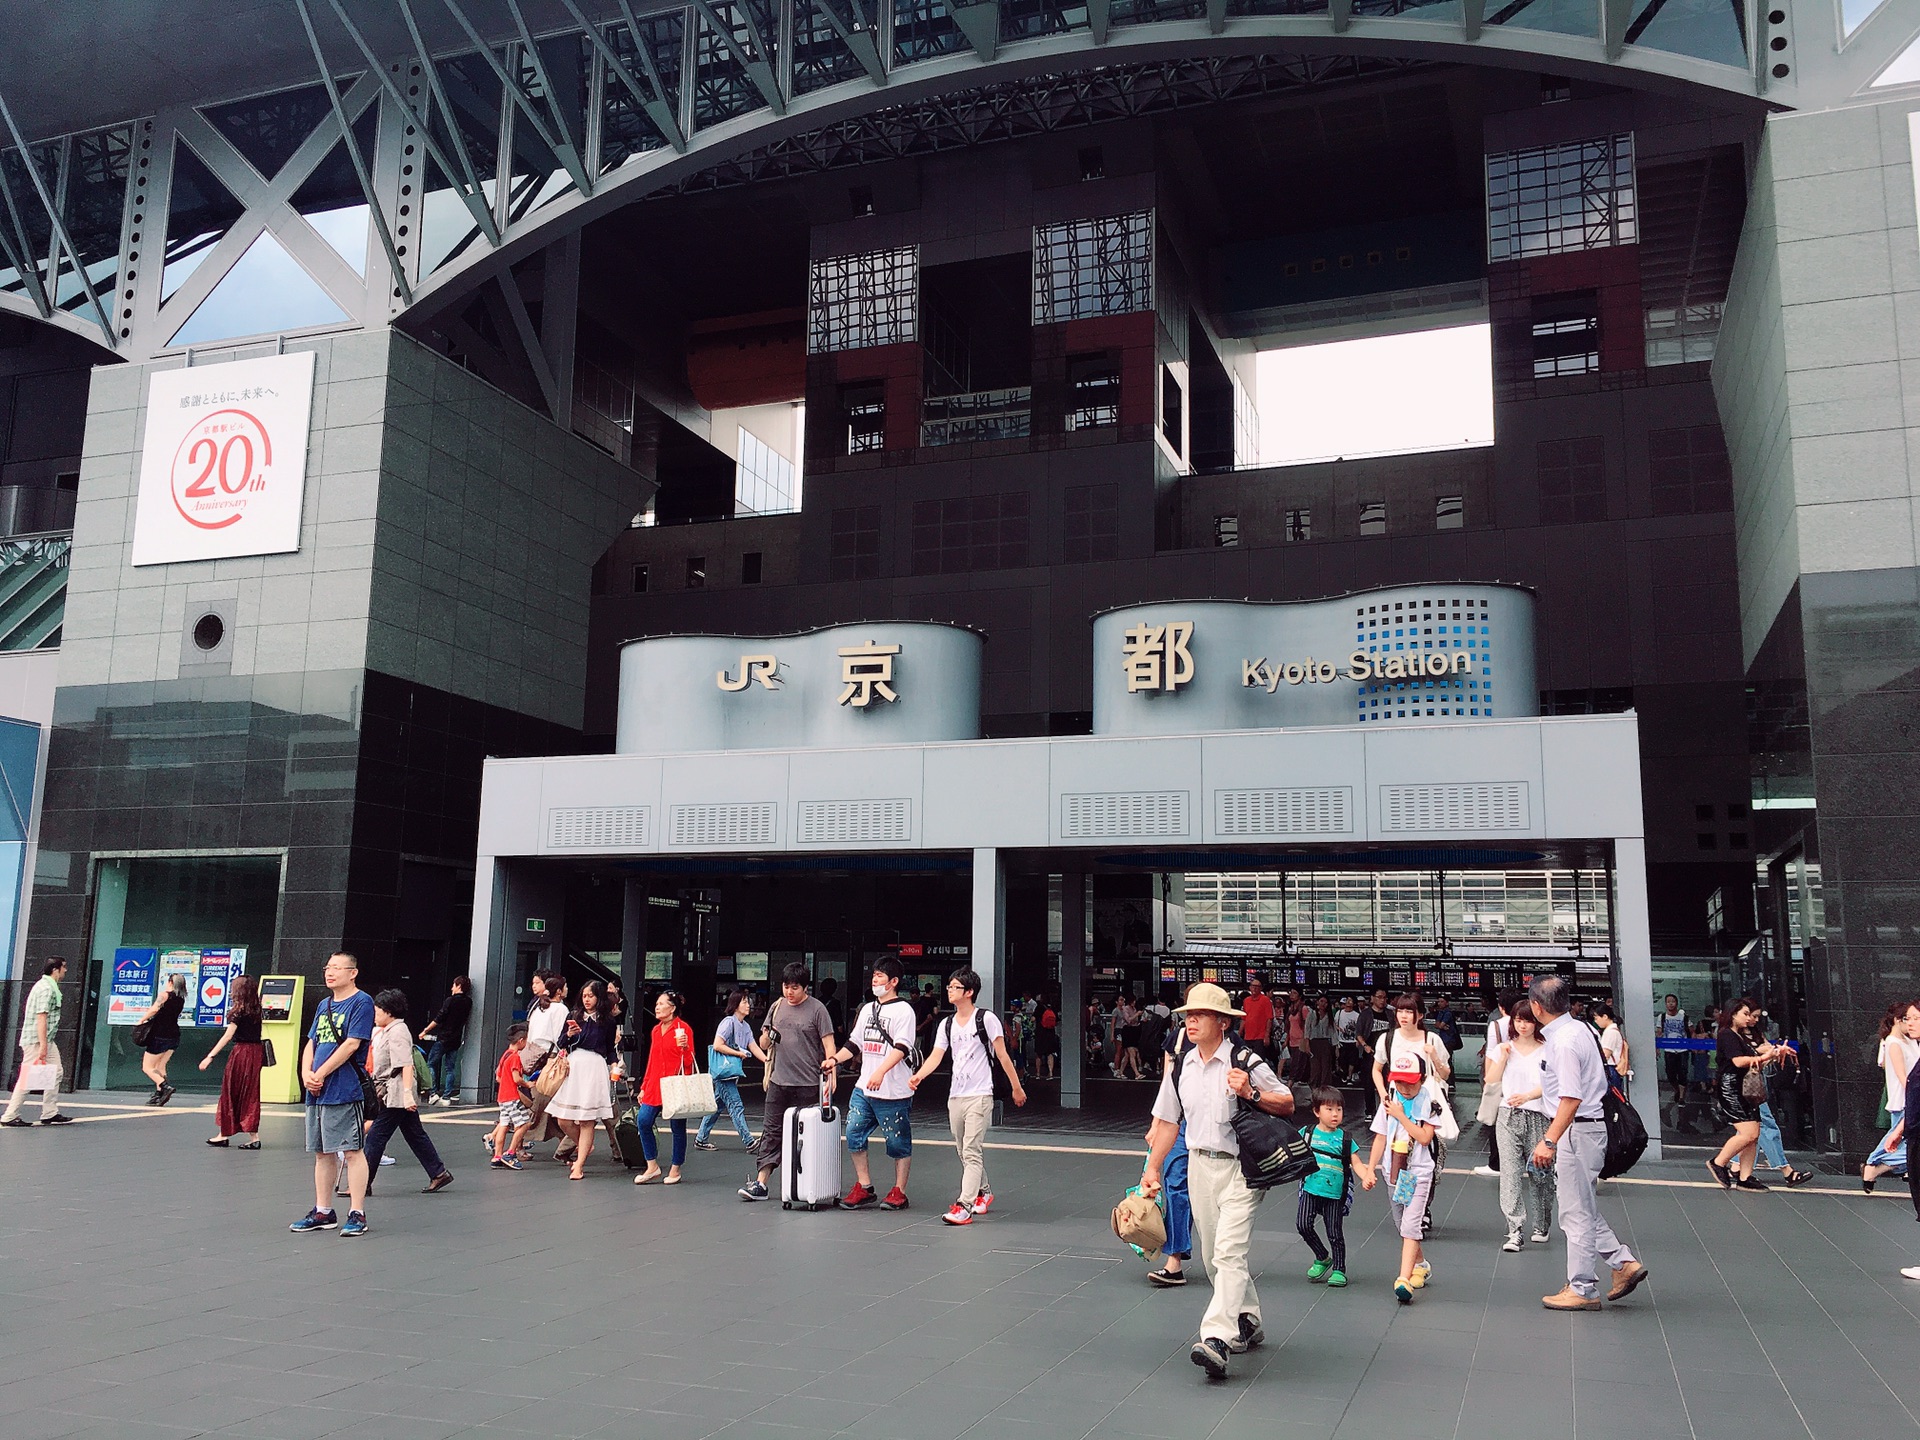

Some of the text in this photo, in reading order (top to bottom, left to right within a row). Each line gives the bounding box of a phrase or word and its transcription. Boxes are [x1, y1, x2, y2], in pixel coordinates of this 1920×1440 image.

[179, 386, 280, 409] 感謝とともに、未来へ。
[203, 422, 245, 434] 京都駅ビル
[191, 498, 249, 512] Anniversary
[1122, 621, 1472, 694] 都 Kyoto Station
[717, 640, 902, 707] JR 京
[118, 969, 148, 979] 日本旅行
